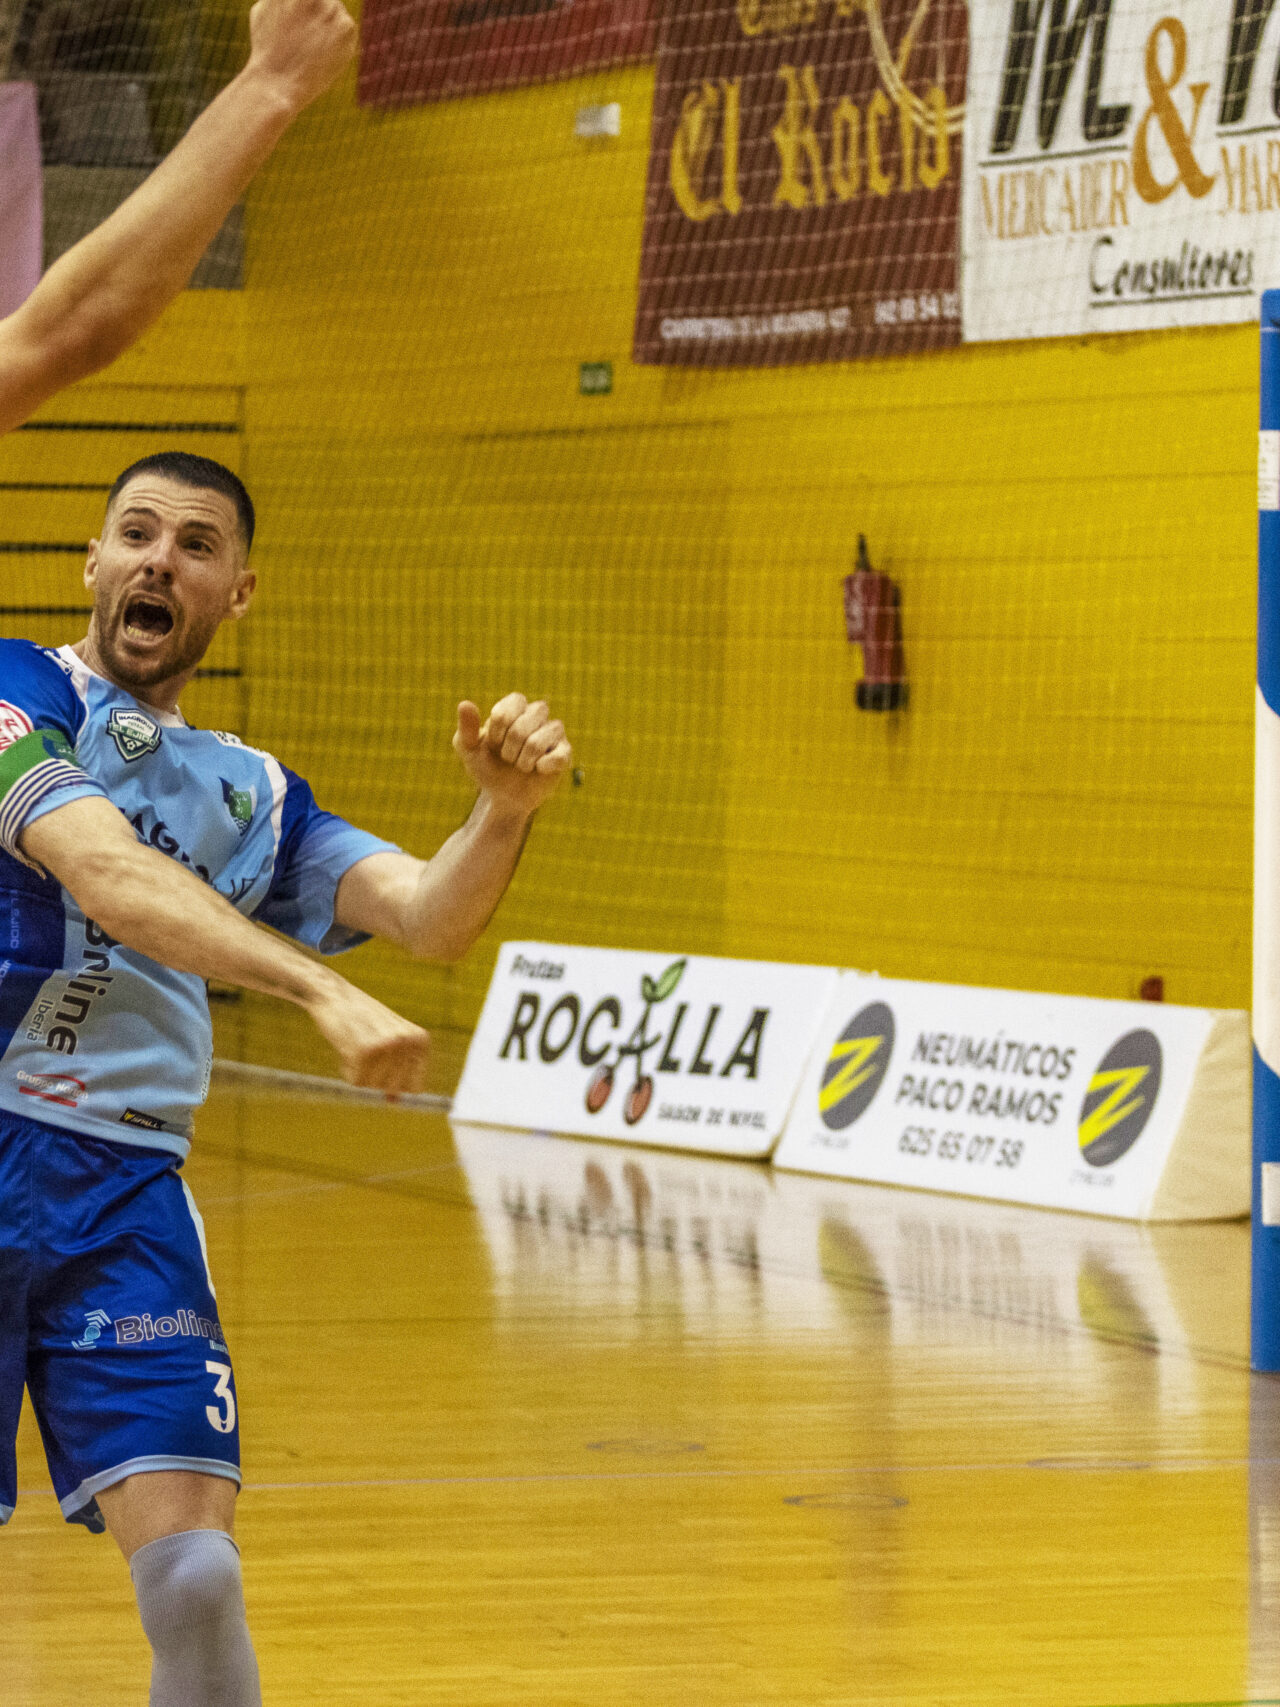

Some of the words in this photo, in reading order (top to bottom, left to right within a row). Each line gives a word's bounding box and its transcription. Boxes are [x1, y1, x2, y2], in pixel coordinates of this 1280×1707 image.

[980, 160, 1131, 241] MERCADER
[1089, 236, 1255, 298] Consultores
[126, 728, 156, 747] EJIDO
[510, 954, 566, 982] Frutas
[26, 999, 55, 1043] Iberia
[498, 990, 772, 1080] ROCALLA
[910, 1031, 1077, 1082] NEUMÁTICOS
[895, 1074, 965, 1112] PACO
[969, 1084, 1064, 1127] RAMOS
[898, 1125, 936, 1157] 625
[937, 1130, 965, 1160] 65
[204, 1360, 237, 1434] 3
